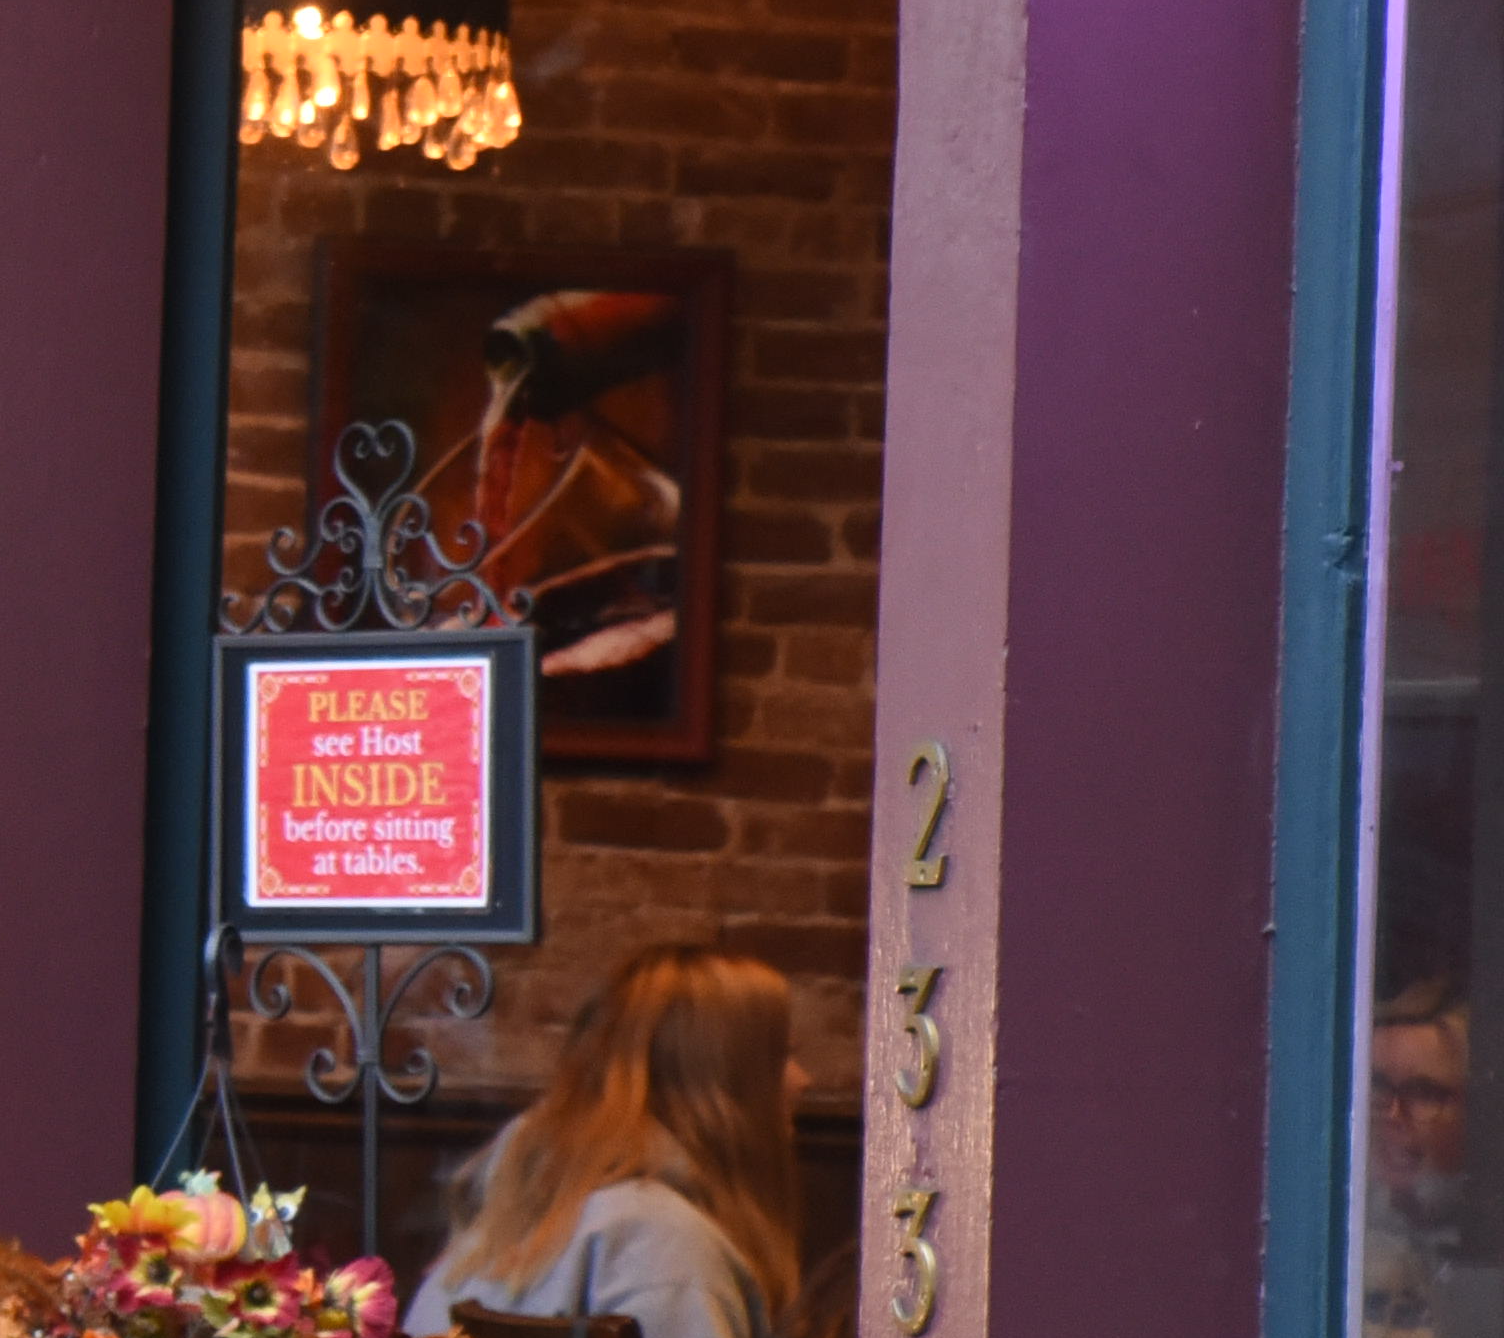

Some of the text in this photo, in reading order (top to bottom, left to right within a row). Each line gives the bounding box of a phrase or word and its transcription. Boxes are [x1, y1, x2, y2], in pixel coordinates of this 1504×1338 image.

[307, 689, 430, 723] PLEASE
[311, 725, 423, 757] see Host
[292, 761, 448, 808] INSIDE
[282, 811, 457, 848] before sitting
[312, 845, 424, 876] at tables.
